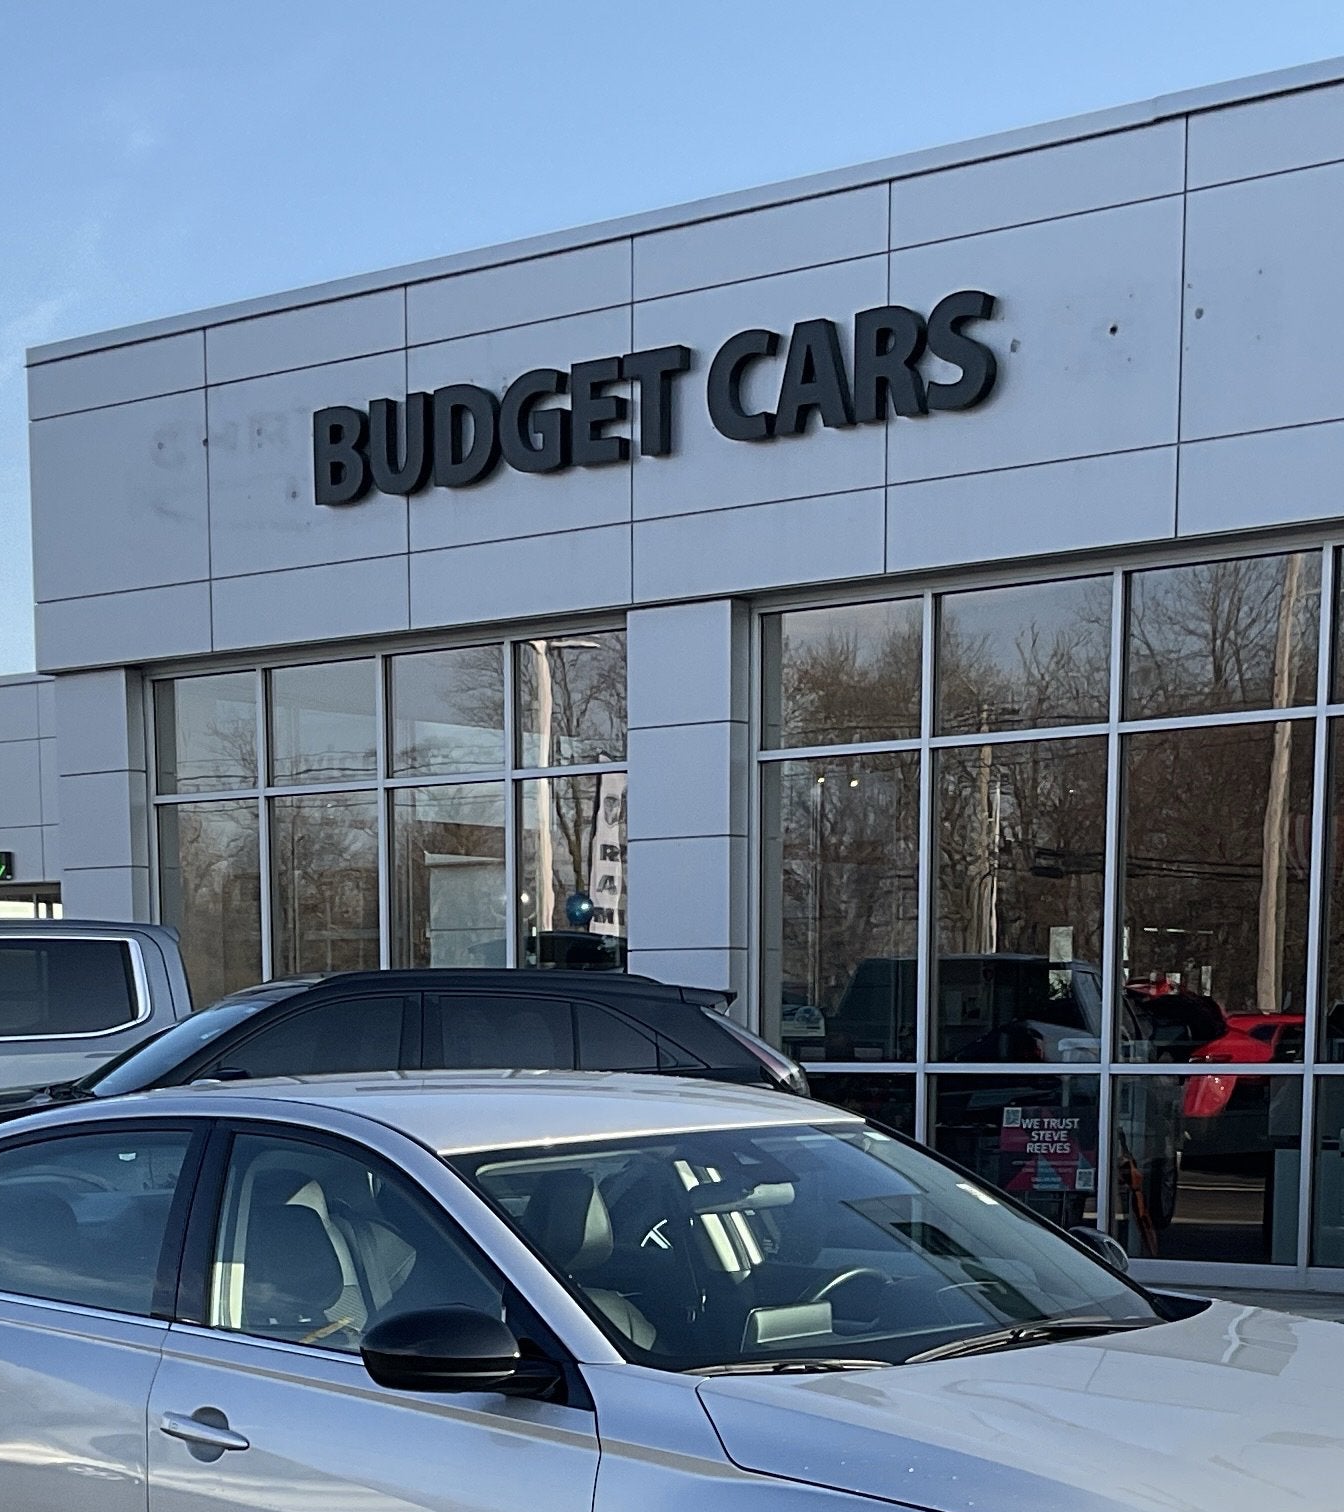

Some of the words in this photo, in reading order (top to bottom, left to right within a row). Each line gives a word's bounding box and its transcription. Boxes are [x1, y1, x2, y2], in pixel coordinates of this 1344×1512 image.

[313, 343, 691, 507] BUDGET
[707, 290, 999, 443] CARS
[1021, 1118, 1039, 1129] WE
[1044, 1118, 1080, 1129] TRUST
[1031, 1130, 1068, 1141] STEVE
[1026, 1142, 1071, 1154] REEVES
